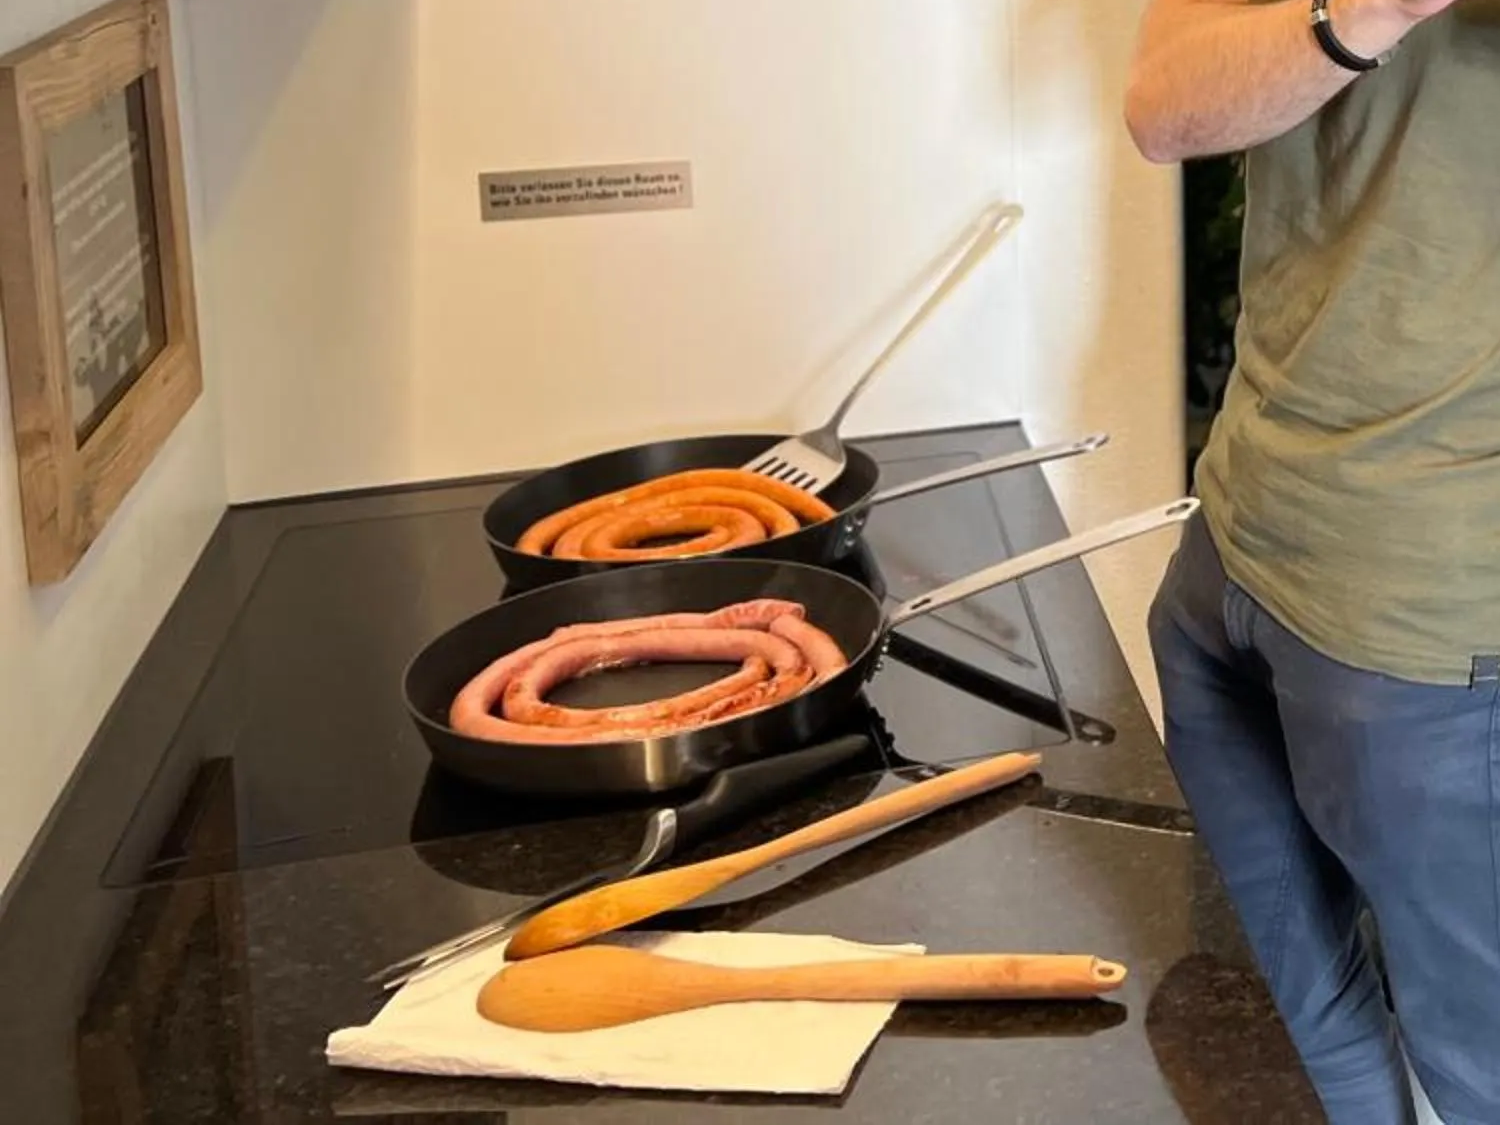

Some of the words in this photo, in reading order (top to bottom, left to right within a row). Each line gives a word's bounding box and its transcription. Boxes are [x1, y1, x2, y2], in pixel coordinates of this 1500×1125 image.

[489, 183, 517, 194] Bitte
[520, 180, 573, 193] verlassen
[576, 177, 593, 189] Sie
[597, 176, 631, 187] diesen
[635, 173, 665, 184] Raum
[490, 197, 511, 208] wie
[514, 194, 532, 206] Sie
